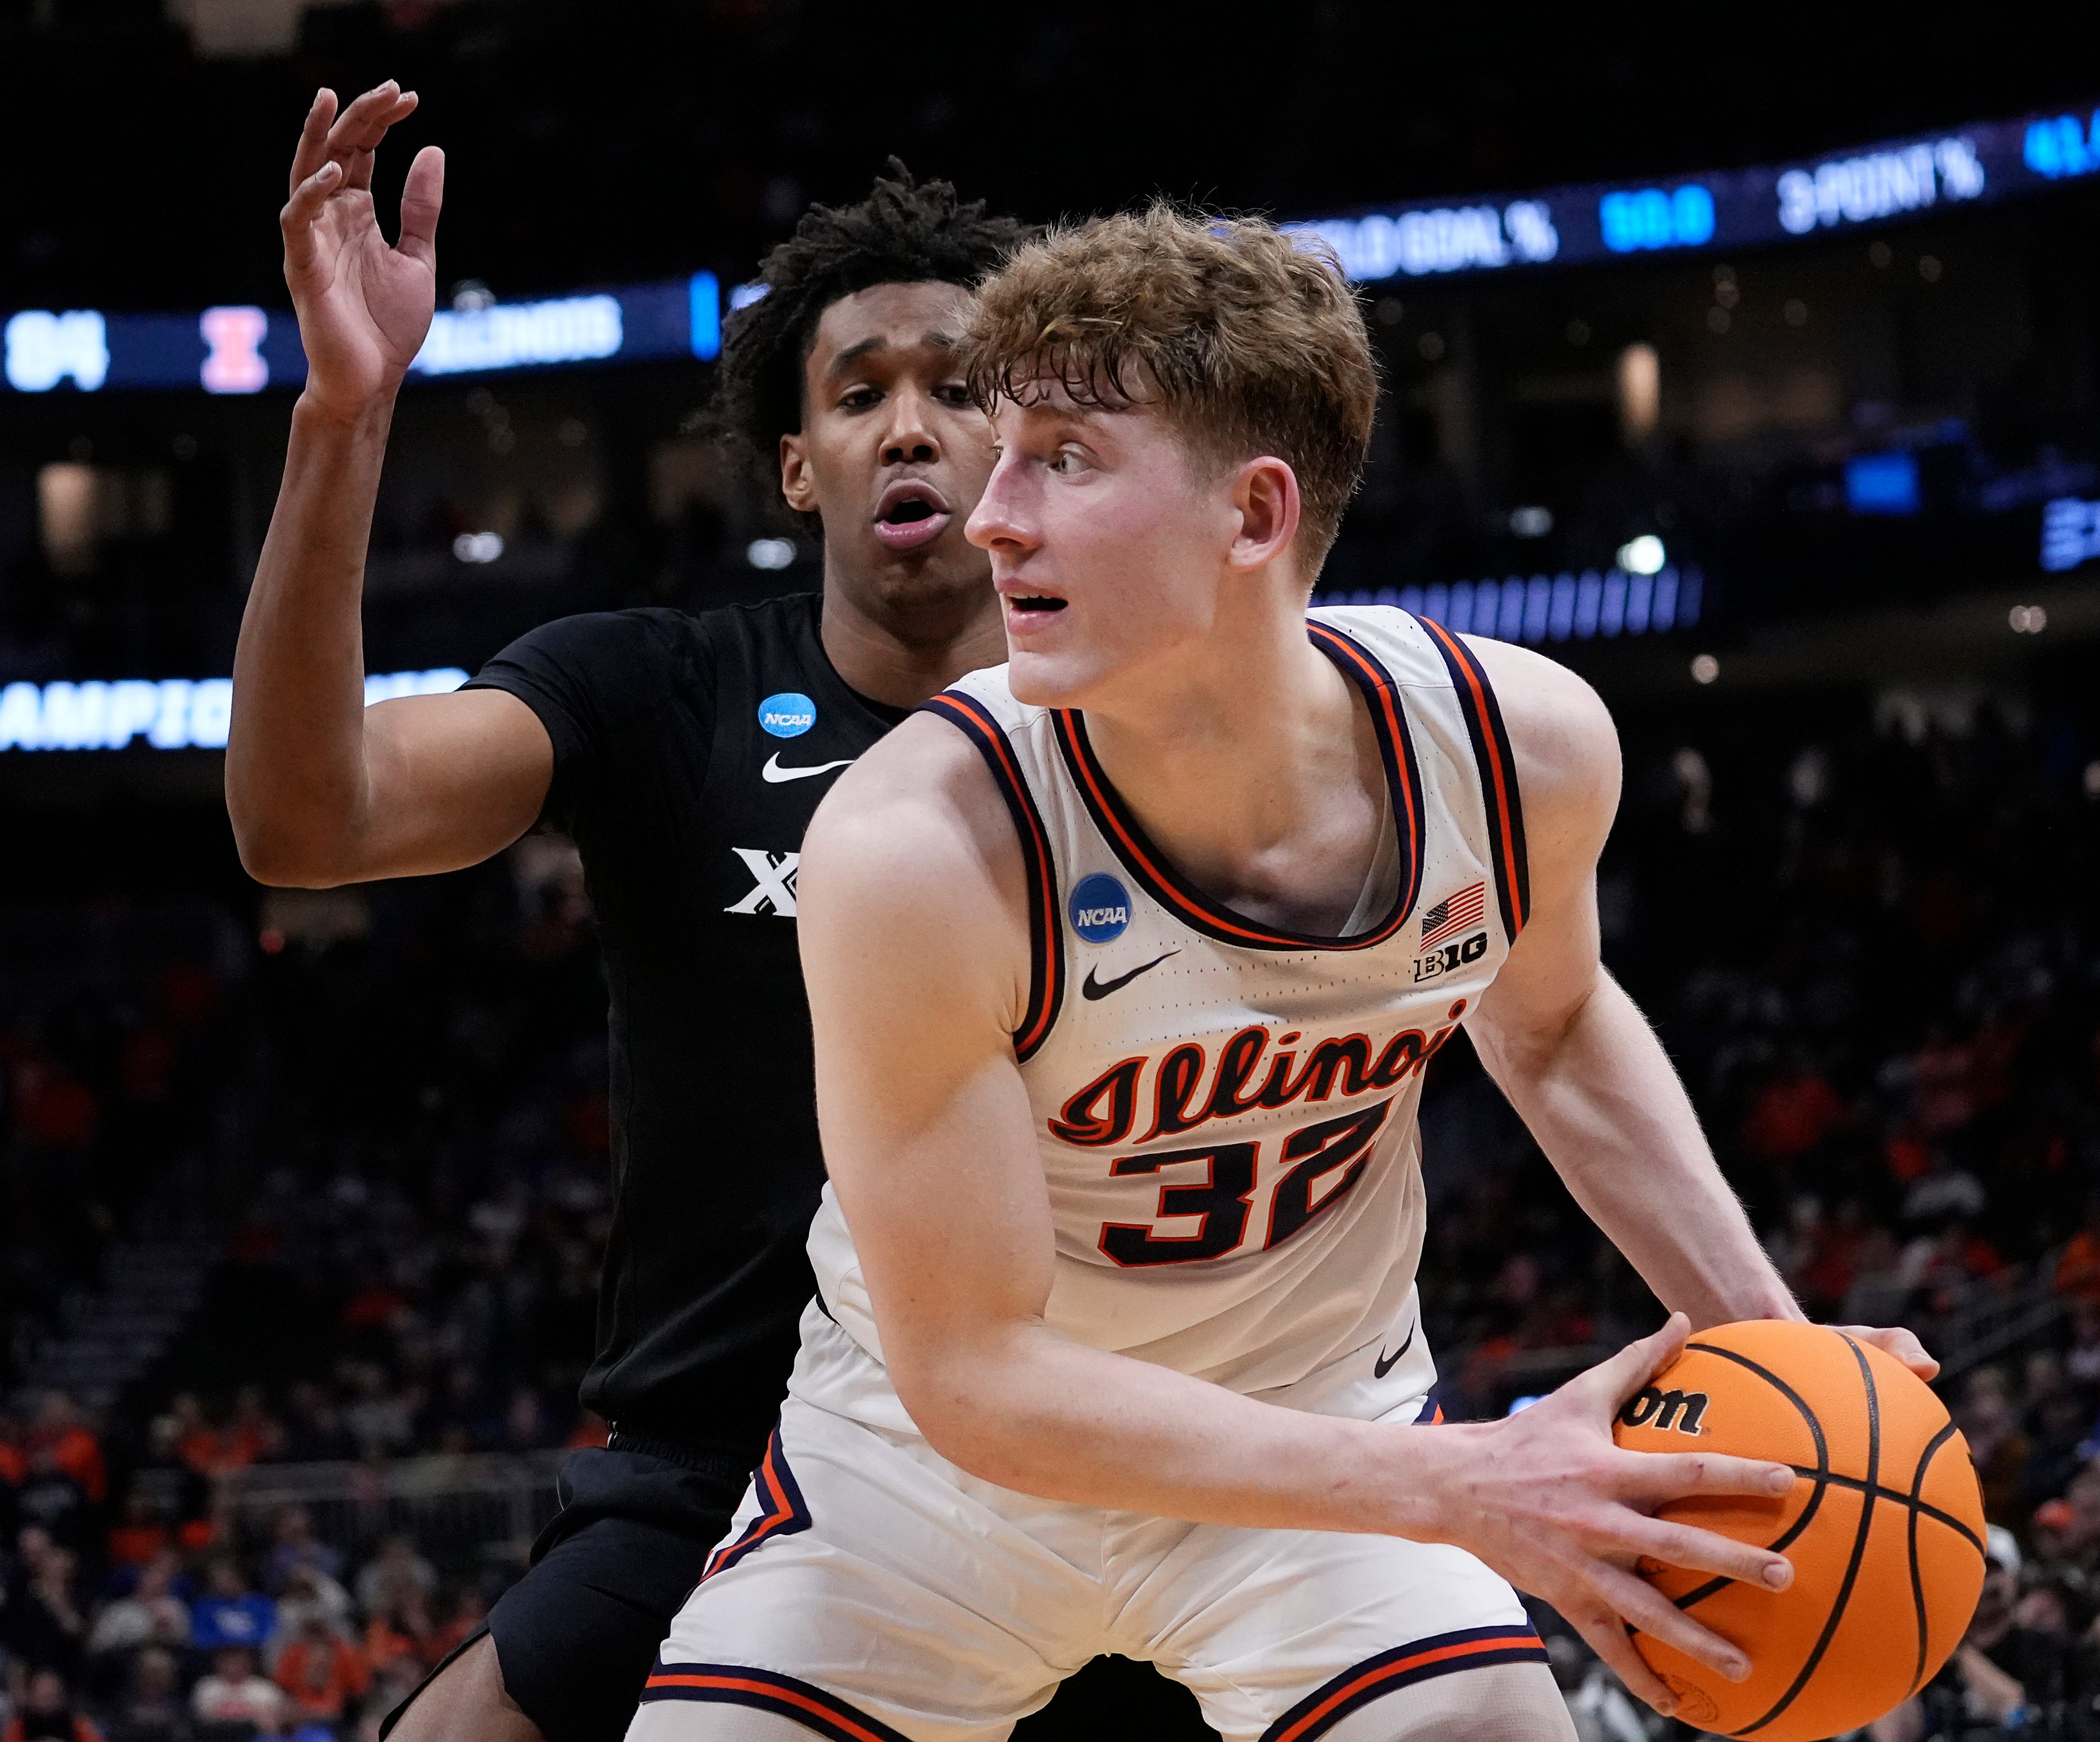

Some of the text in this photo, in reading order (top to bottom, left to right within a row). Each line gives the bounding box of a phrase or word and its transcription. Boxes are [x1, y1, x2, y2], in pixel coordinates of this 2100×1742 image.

[764, 713, 813, 726] NCAA
[1078, 907, 1127, 927] NCAA
[1098, 1091, 1398, 1267] 32
